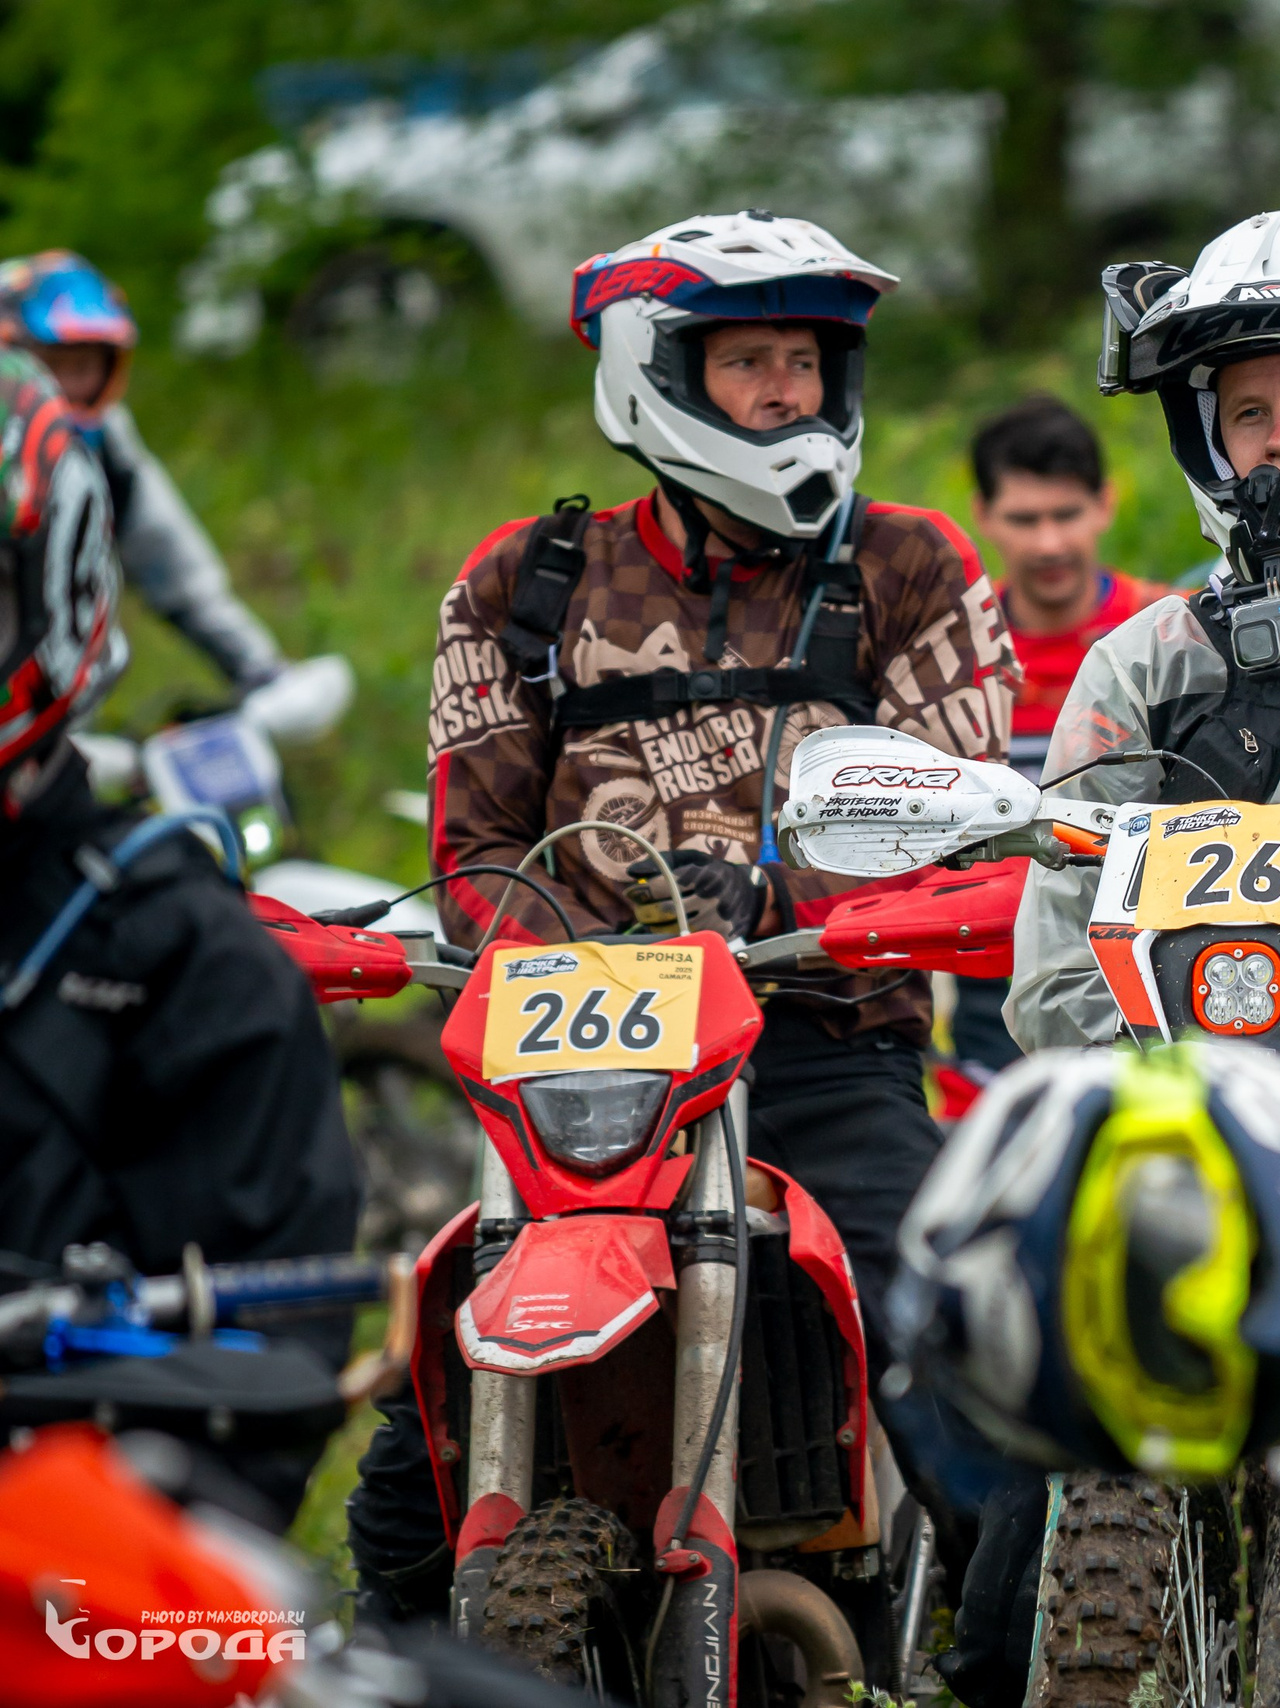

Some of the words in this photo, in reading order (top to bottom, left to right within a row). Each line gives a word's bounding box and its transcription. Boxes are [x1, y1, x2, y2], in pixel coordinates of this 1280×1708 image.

[641, 707, 755, 771] ENDURO
[825, 797, 903, 807] PROTECTION
[819, 807, 844, 818] FOR
[847, 808, 899, 817] ENDURO
[1133, 819, 1149, 829] FIM
[1180, 813, 1218, 824] ТОЧКА
[636, 952, 693, 963] БРОНЗА
[658, 973, 692, 981] САМАРА
[517, 988, 662, 1055] 266
